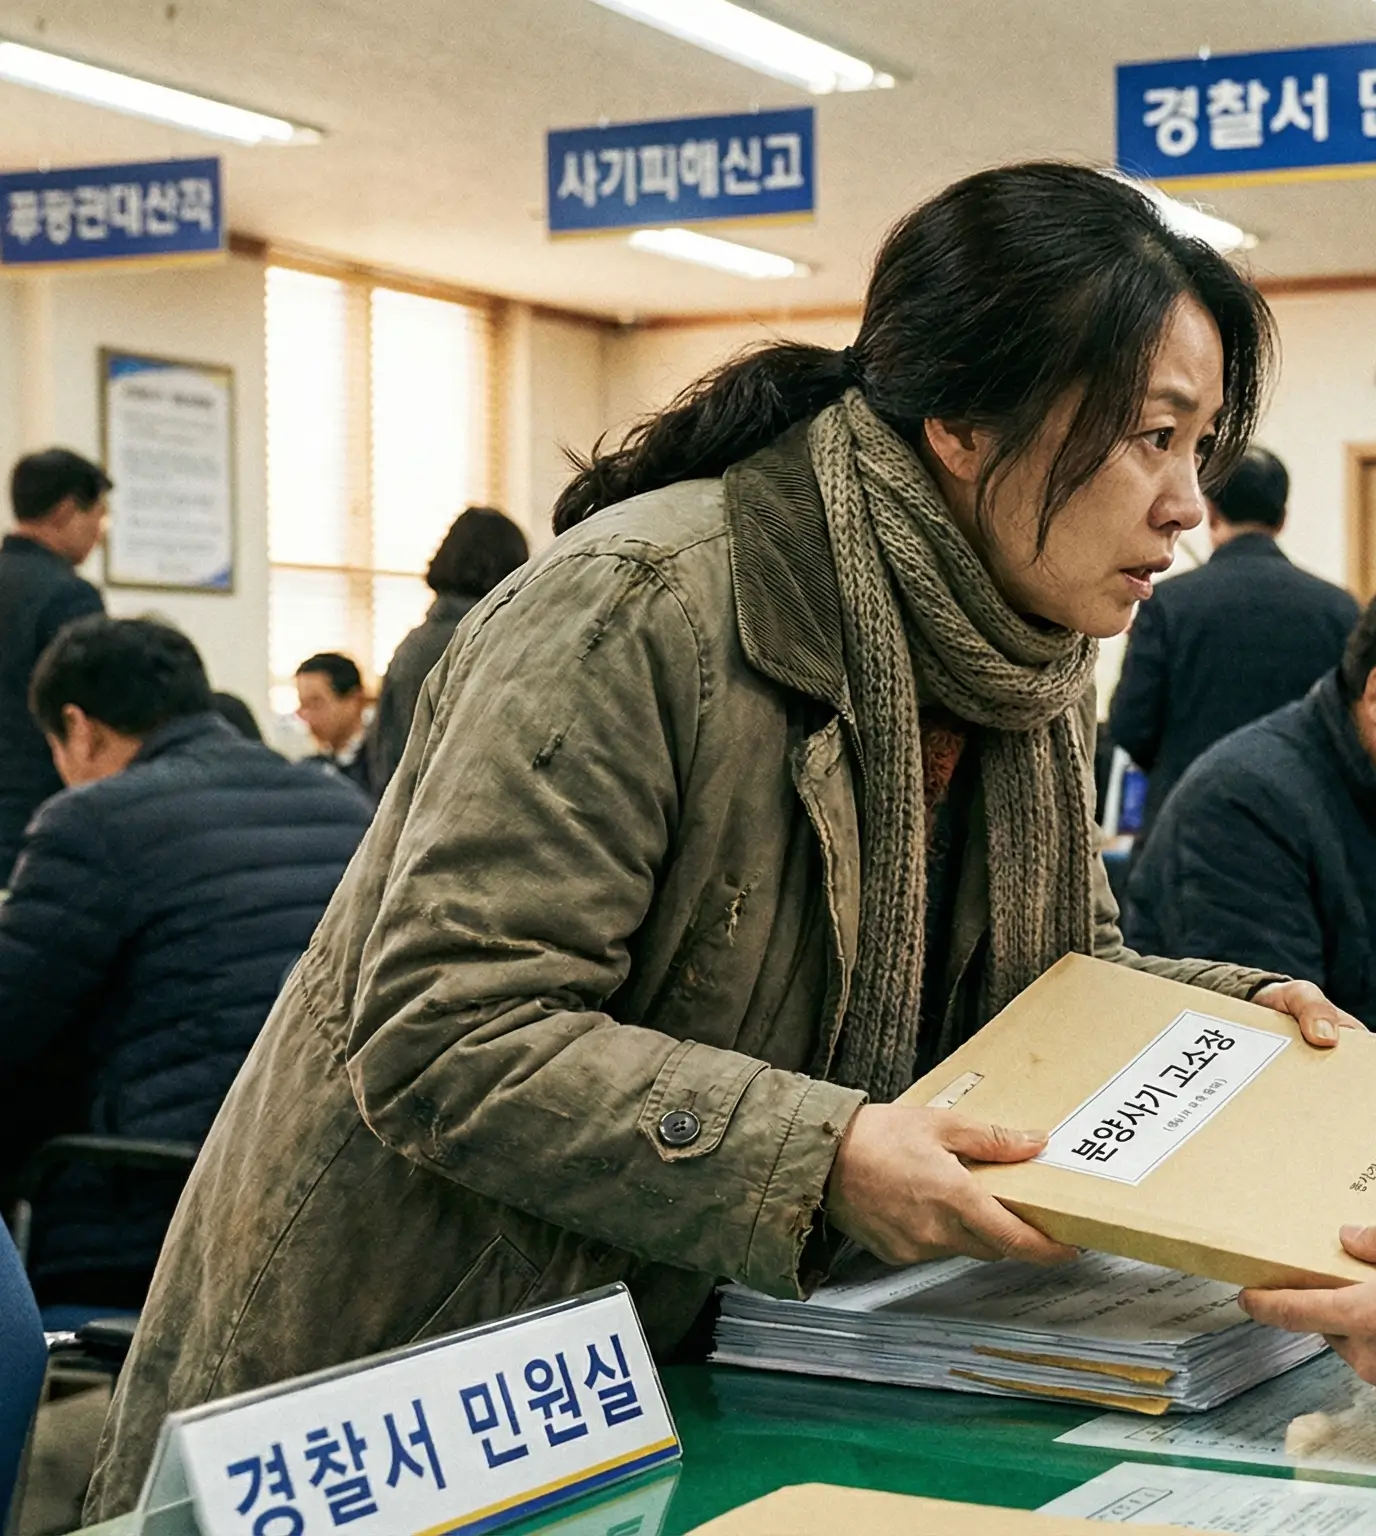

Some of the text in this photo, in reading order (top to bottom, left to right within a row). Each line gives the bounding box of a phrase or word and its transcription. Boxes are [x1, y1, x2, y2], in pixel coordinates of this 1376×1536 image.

[1142, 74, 1330, 157] 경찰서
[557, 132, 805, 208] 사기피해신고
[1071, 1083, 1178, 1162] 분양사기
[1158, 1028, 1236, 1088] 고소장
[226, 1333, 644, 1536] 경찰서 민원실
